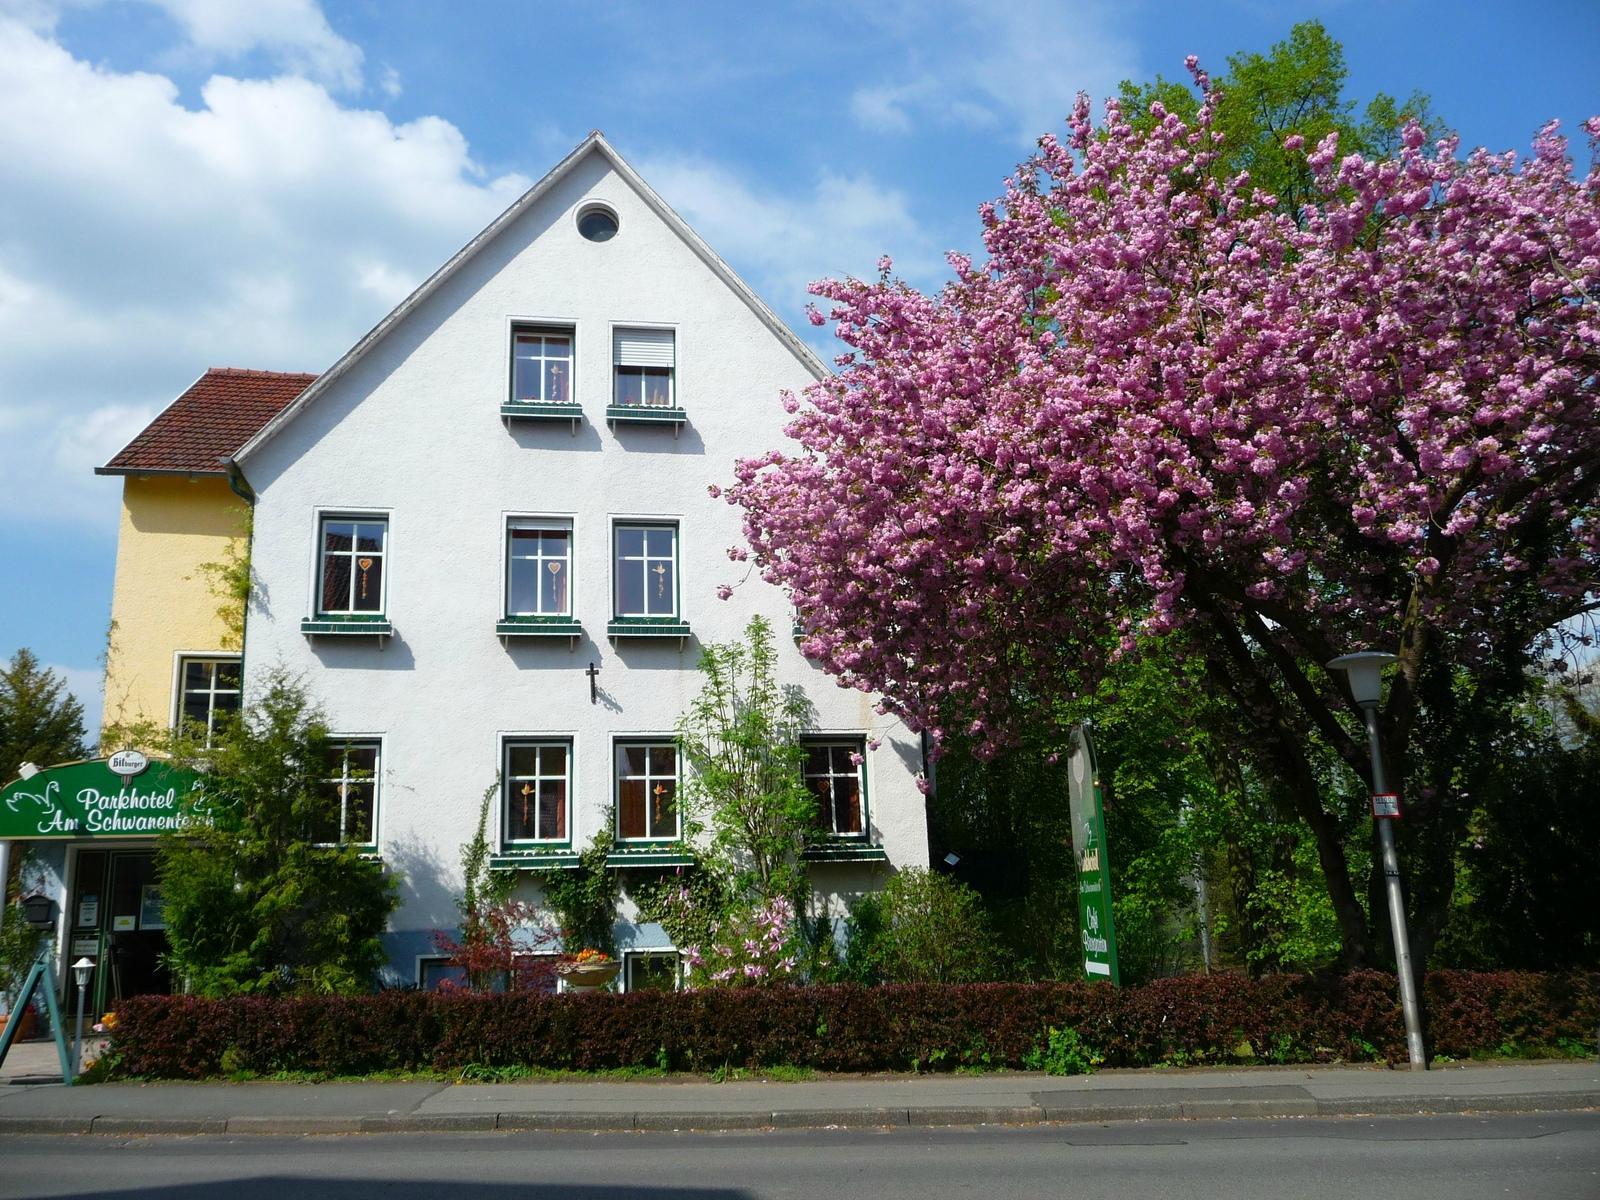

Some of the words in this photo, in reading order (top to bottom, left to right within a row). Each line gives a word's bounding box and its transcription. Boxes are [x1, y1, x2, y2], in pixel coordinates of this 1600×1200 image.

[113, 757, 144, 769] Bitburger
[76, 787, 175, 810] Parkhotel
[37, 809, 79, 833] Am
